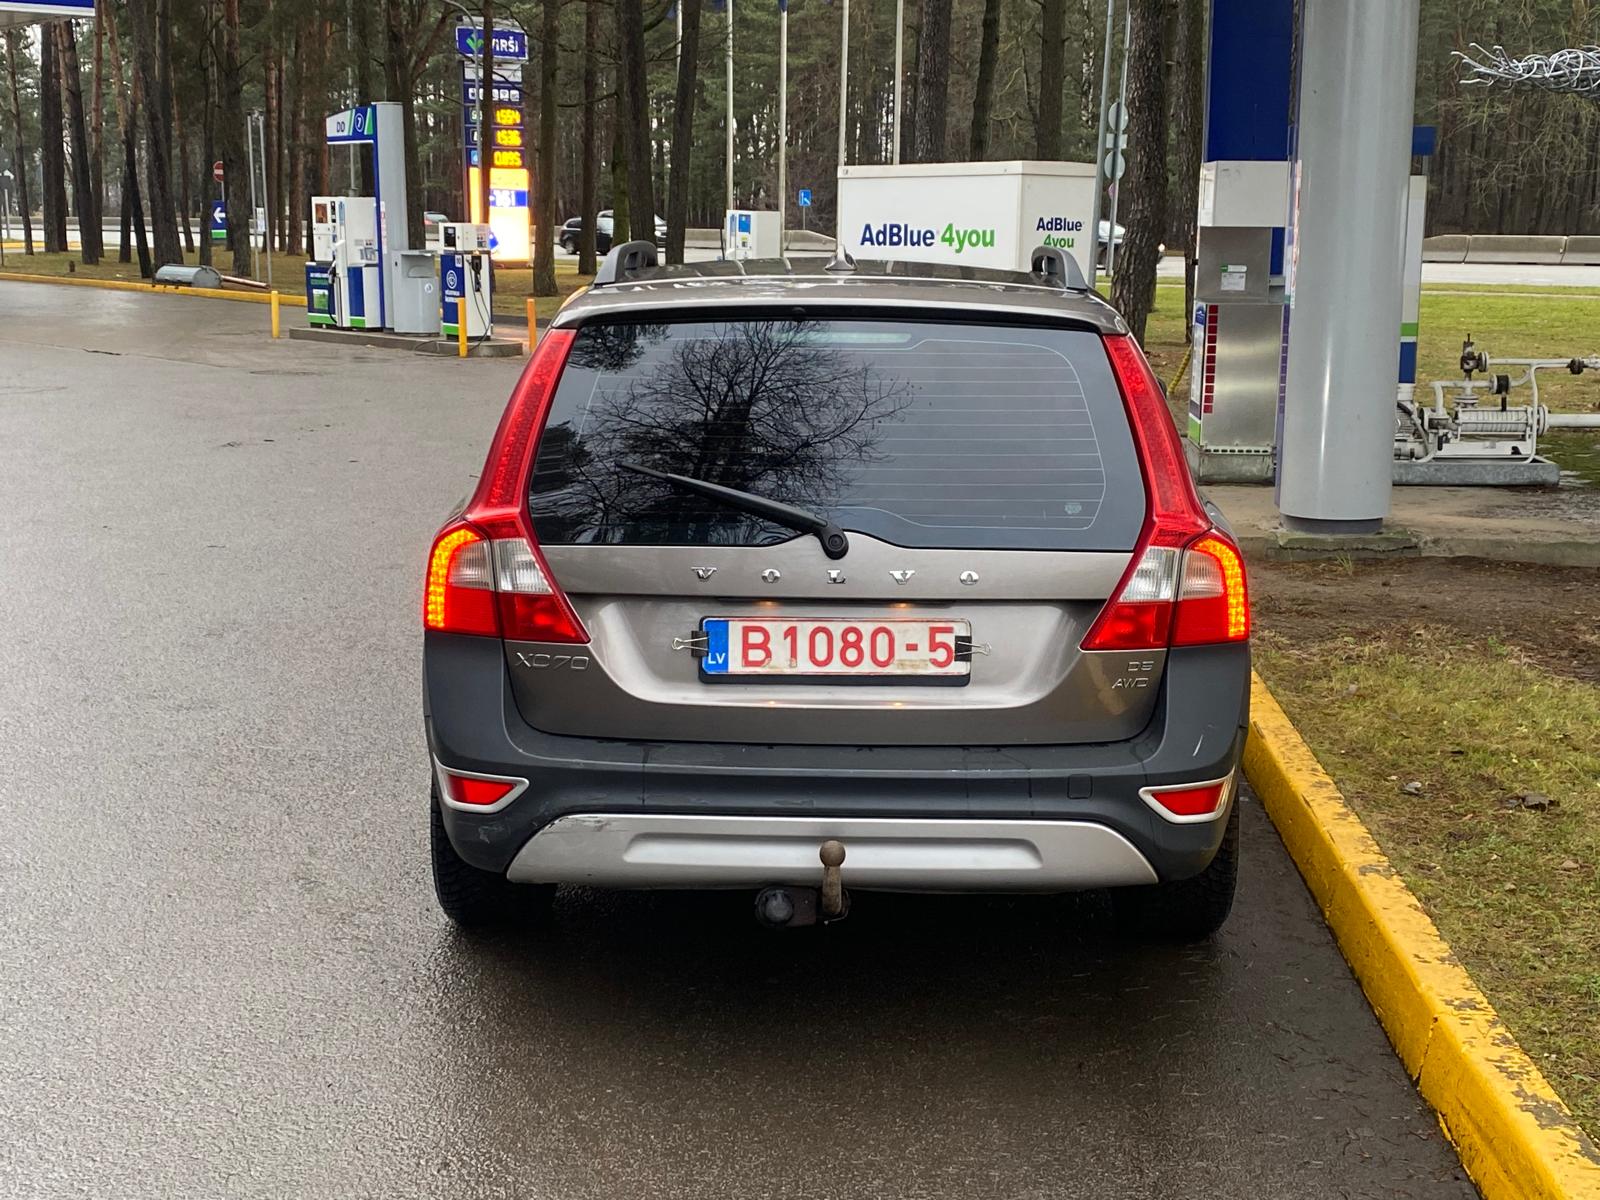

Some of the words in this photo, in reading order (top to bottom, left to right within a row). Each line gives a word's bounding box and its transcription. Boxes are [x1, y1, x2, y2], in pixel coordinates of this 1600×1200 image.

[1036, 217, 1083, 232] AdBlue
[860, 223, 935, 247] AdBlue
[941, 223, 995, 254] 4you
[690, 566, 980, 586] VOLVO
[514, 652, 590, 670] XC70
[707, 652, 726, 665] LV
[1127, 660, 1155, 672] D5
[1111, 677, 1150, 689] AWD
